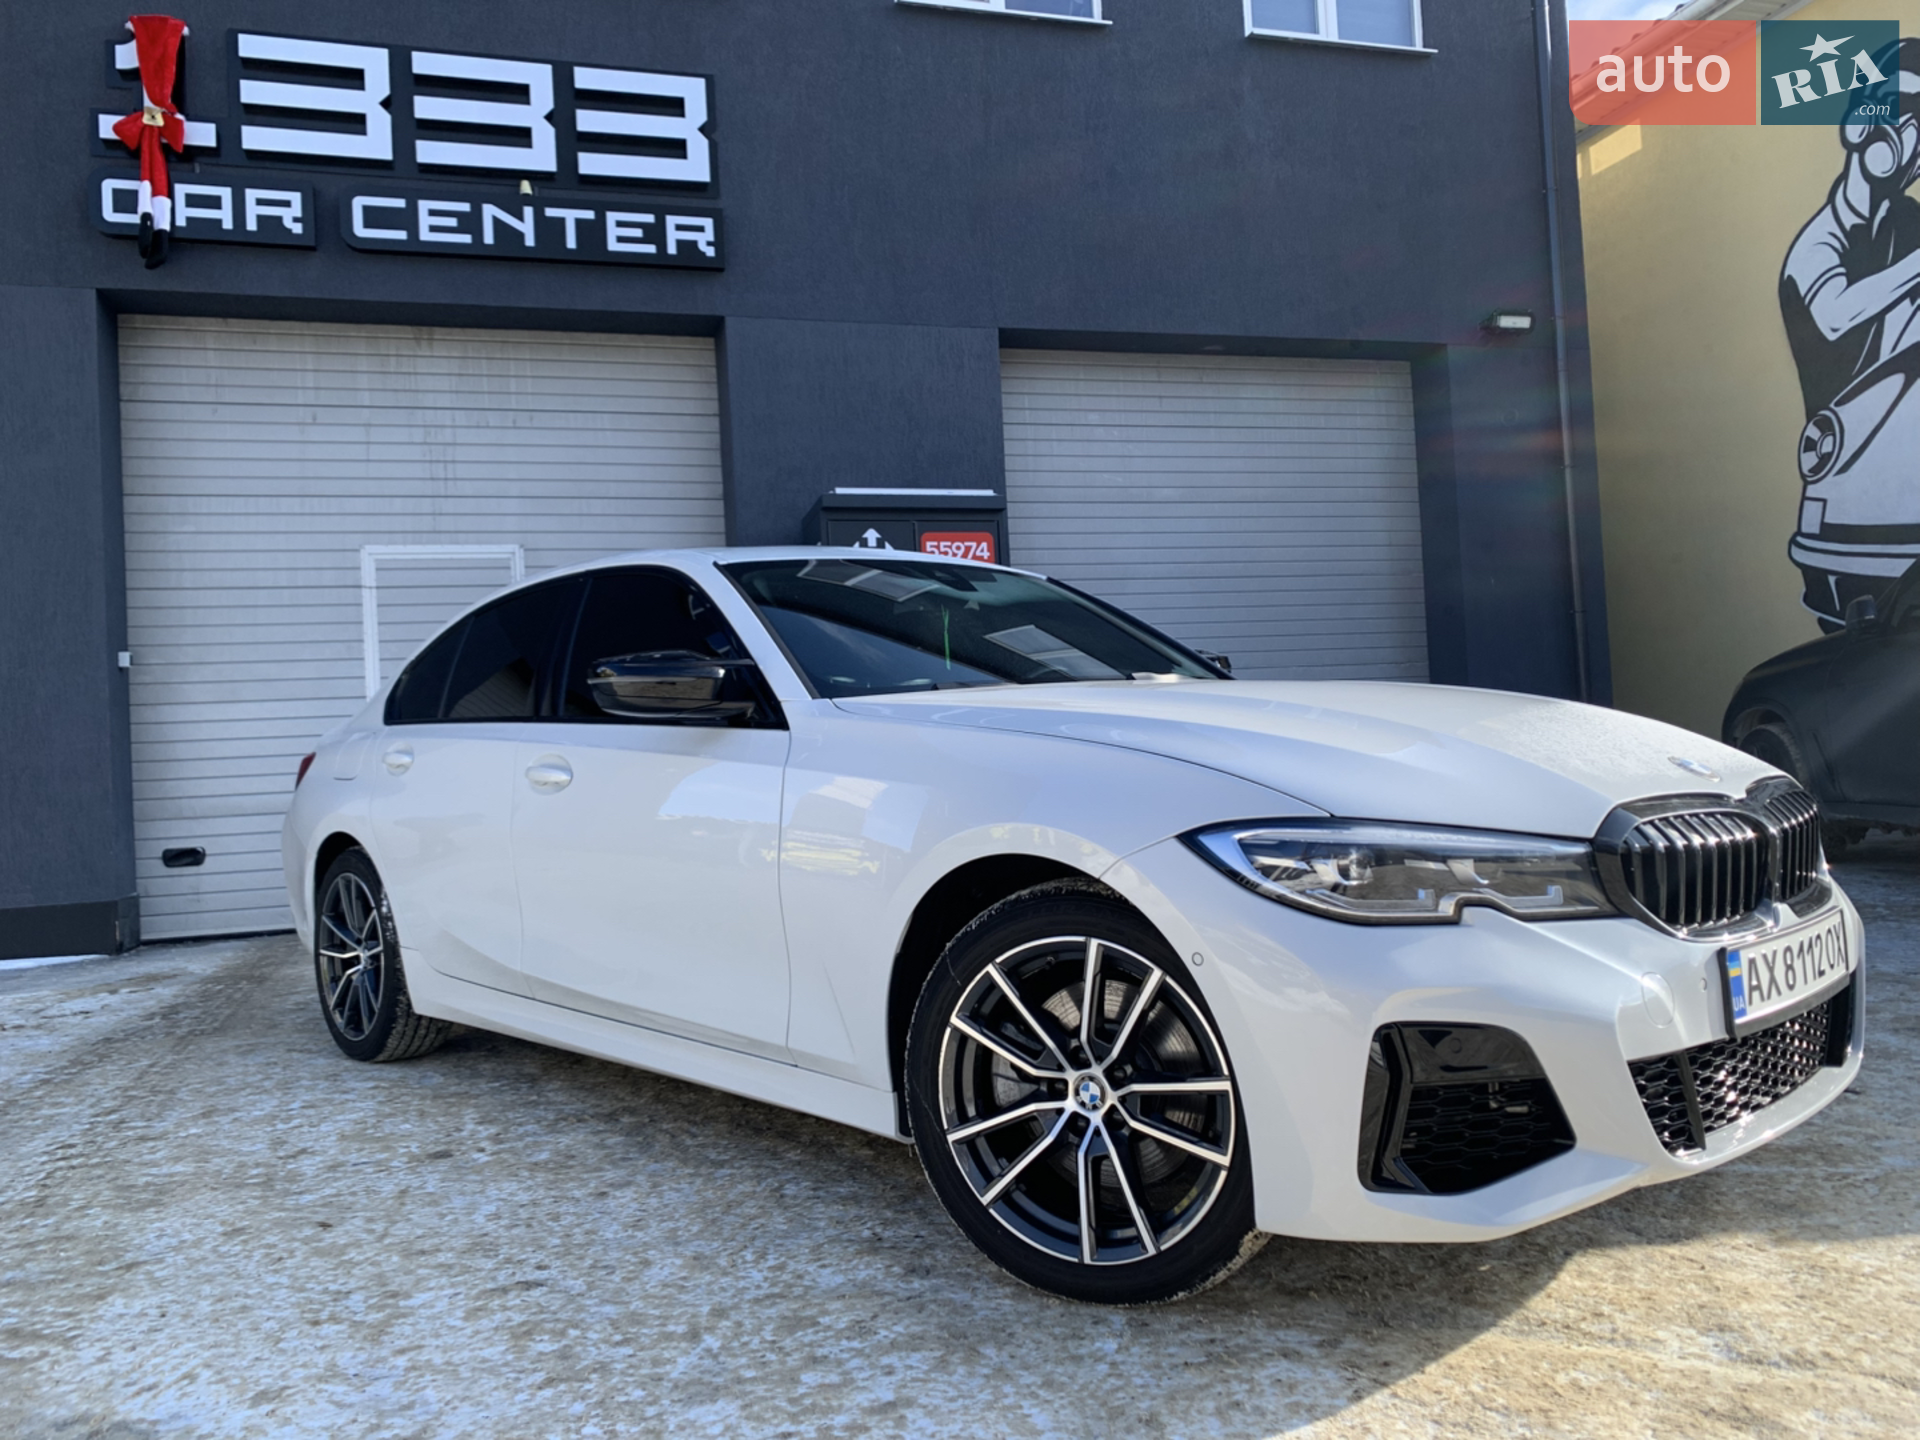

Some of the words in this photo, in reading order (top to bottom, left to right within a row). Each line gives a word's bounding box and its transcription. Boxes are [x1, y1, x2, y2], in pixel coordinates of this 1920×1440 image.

[100, 177, 304, 235] CAR
[352, 195, 716, 258] CENTER
[926, 541, 990, 560] 55974
[1733, 995, 1746, 1012] UA
